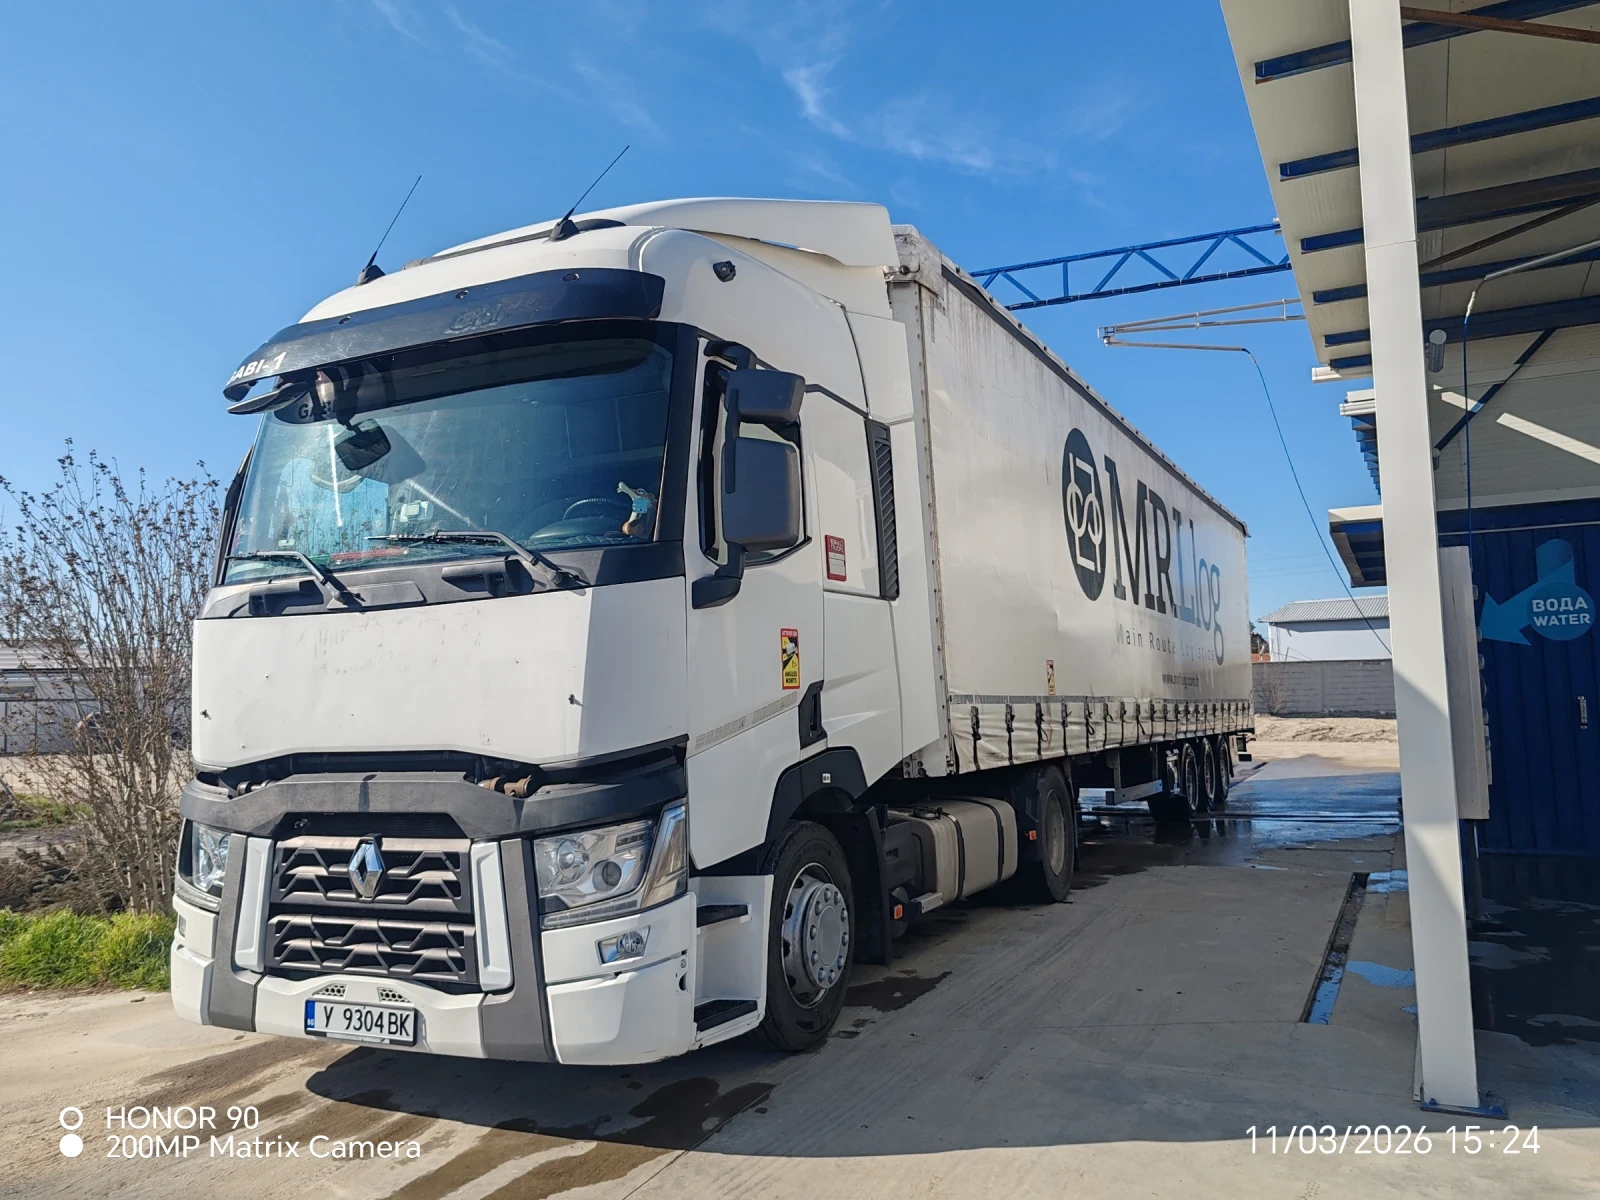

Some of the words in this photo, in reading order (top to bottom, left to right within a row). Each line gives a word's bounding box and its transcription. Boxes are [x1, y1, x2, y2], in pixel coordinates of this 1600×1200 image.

[1532, 597, 1588, 612] ВОДА
[1533, 613, 1590, 626] WATER
[1116, 623, 1143, 648] Main
[1148, 631, 1177, 655] Route
